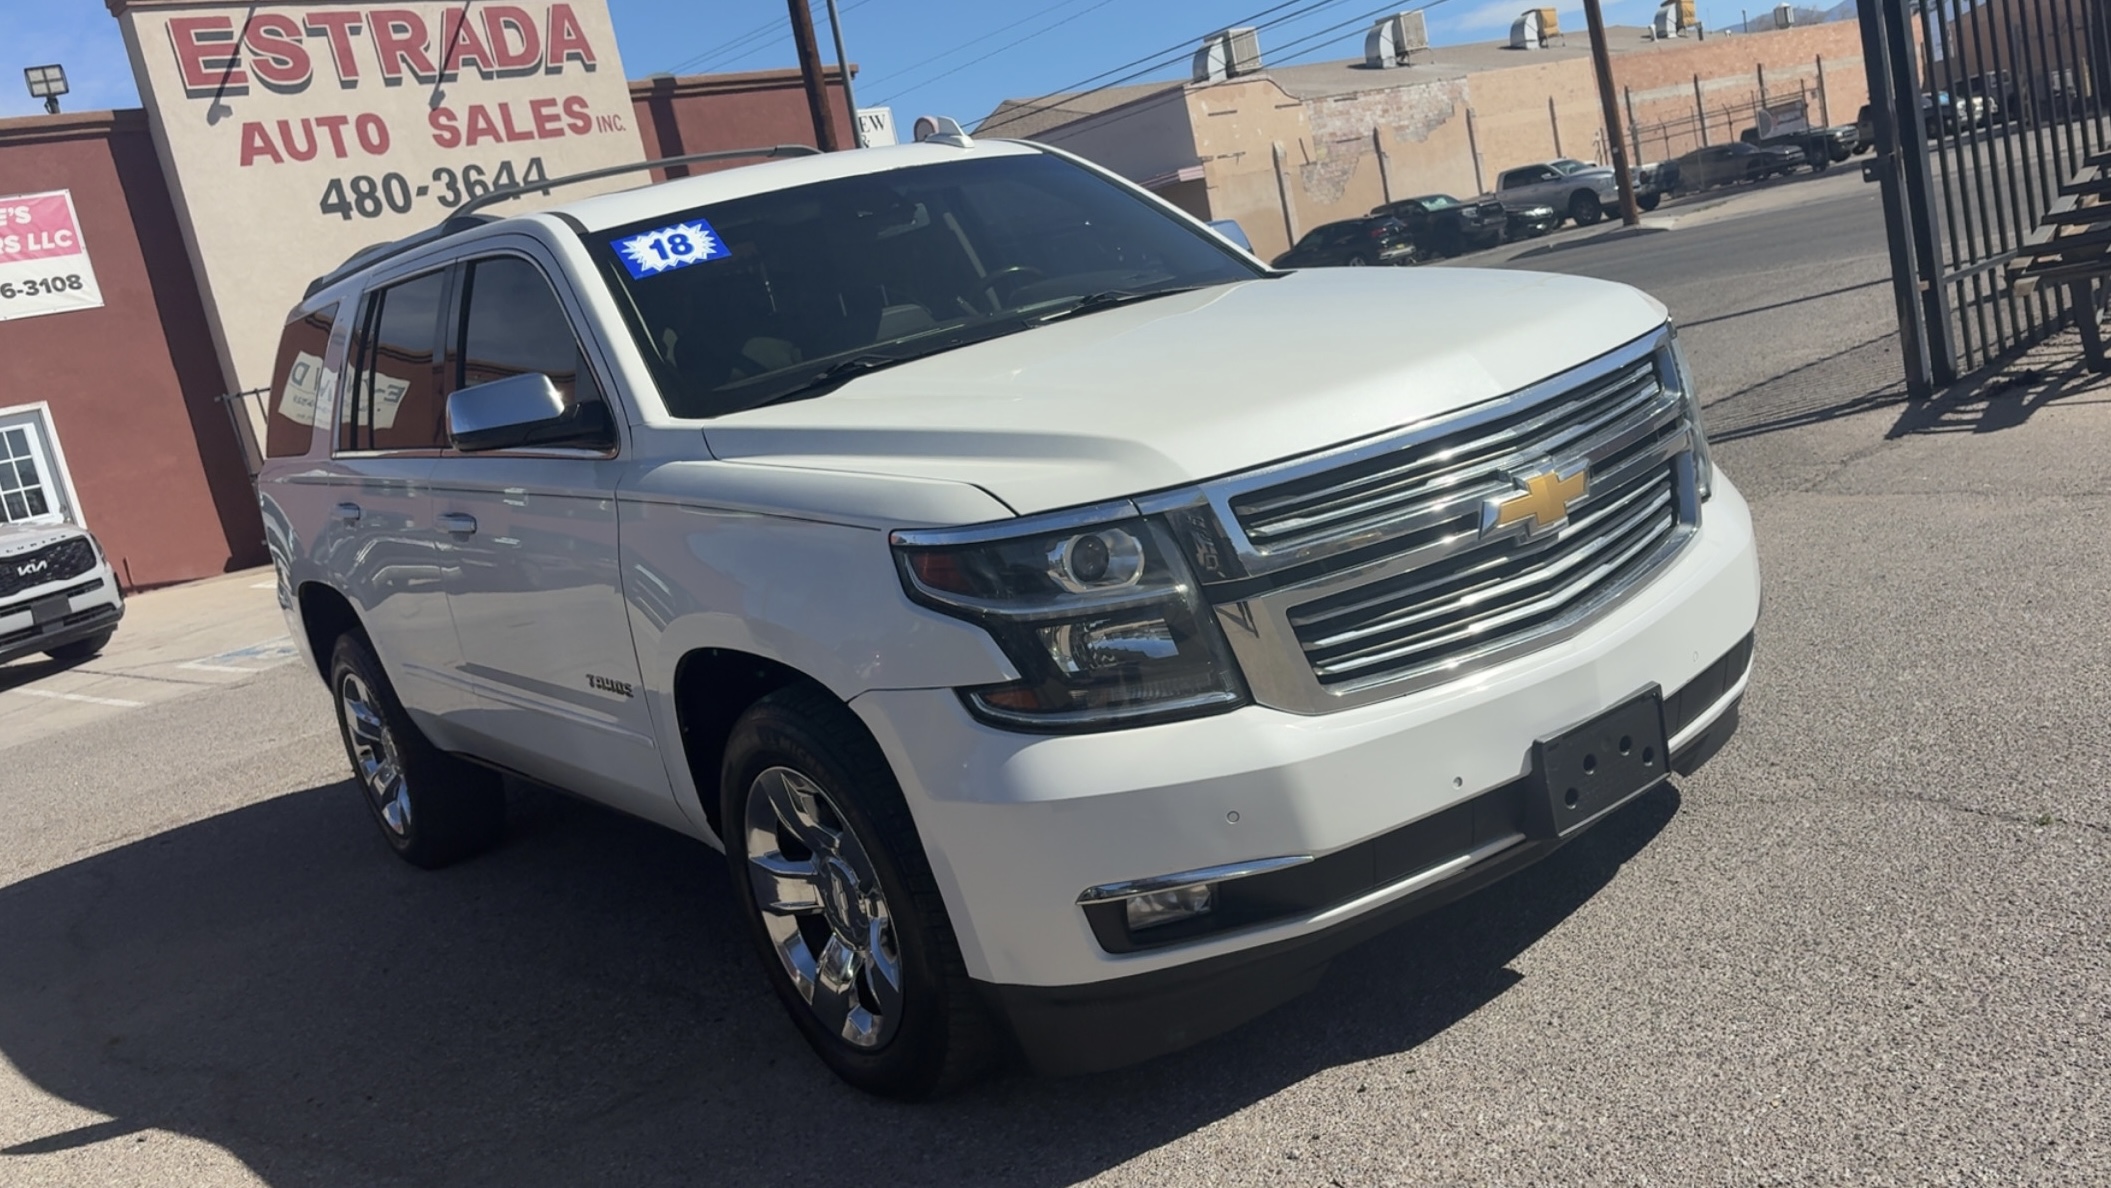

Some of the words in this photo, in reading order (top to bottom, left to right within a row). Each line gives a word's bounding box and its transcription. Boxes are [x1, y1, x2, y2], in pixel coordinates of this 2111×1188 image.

[165, 3, 597, 99] ESTRADA
[239, 112, 391, 167] AUTO
[427, 95, 593, 149] SALES
[596, 113, 627, 134] INC.
[319, 156, 552, 221] 480-3644
[27, 228, 73, 252] LLC
[648, 232, 695, 262] 18
[0, 273, 83, 299] 6-3108
[17, 560, 48, 577] KIA
